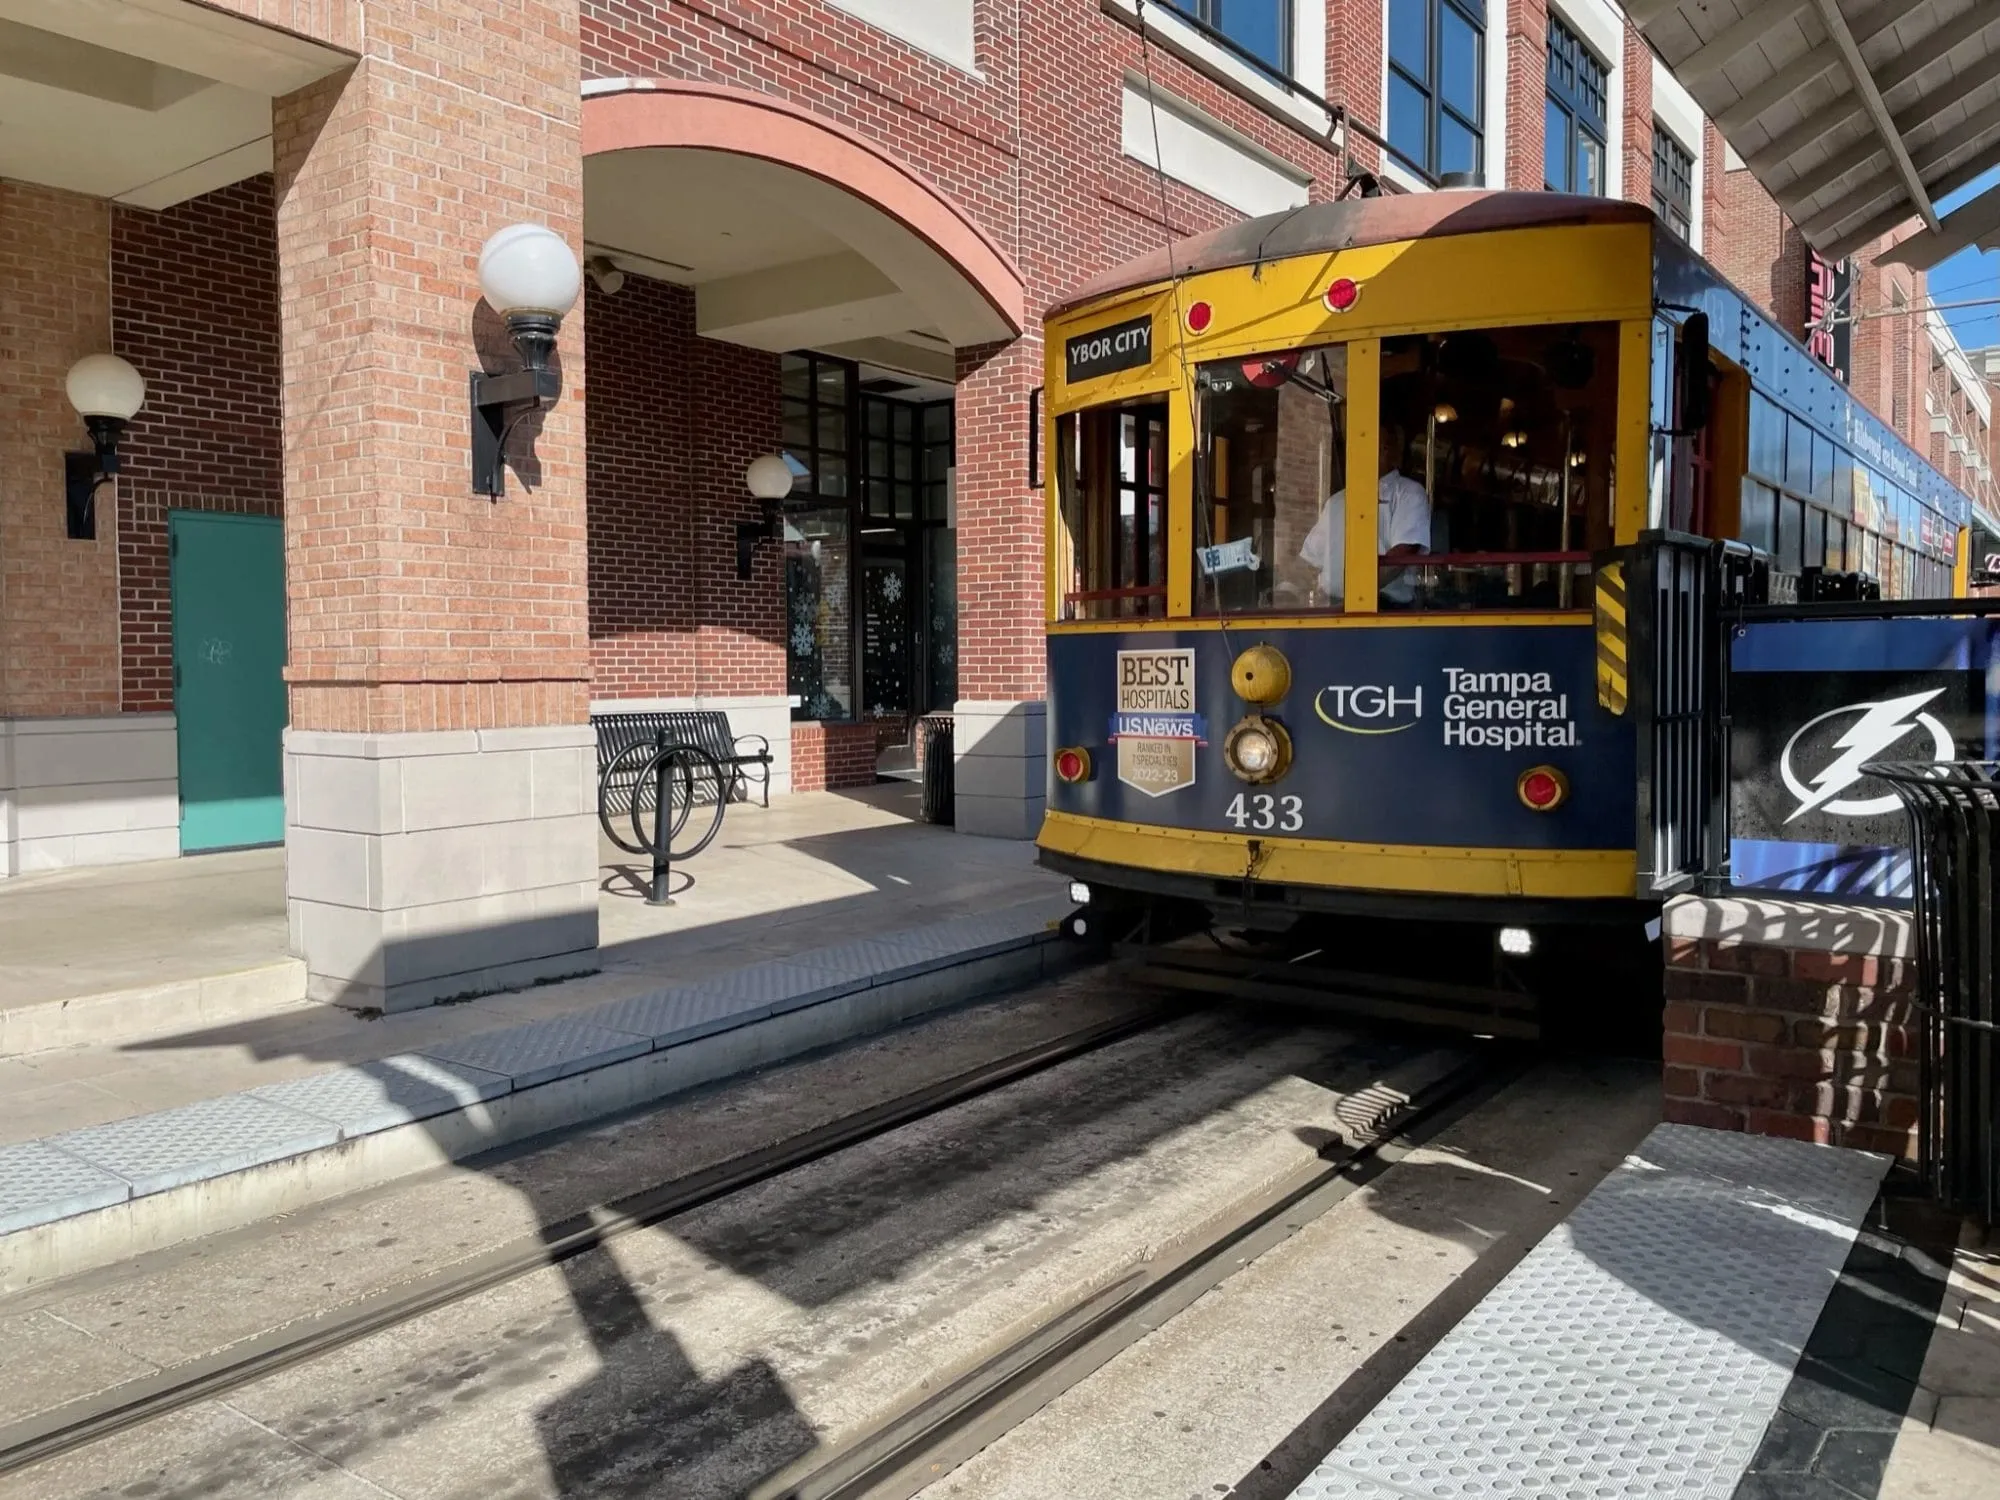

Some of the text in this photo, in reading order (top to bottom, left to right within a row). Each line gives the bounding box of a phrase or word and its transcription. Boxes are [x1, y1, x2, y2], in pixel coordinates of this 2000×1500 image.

[1071, 325, 1151, 365] YBOR CITY
[1121, 656, 1189, 686] BEST
[1442, 667, 1552, 698] Tampa
[1121, 689, 1189, 709] HOSPITALS
[1328, 685, 1422, 718] TGH
[1443, 694, 1567, 720] General
[1137, 742, 1171, 754] RANKED IN
[1132, 768, 1178, 782] 2022-23
[1225, 793, 1304, 831] 433
